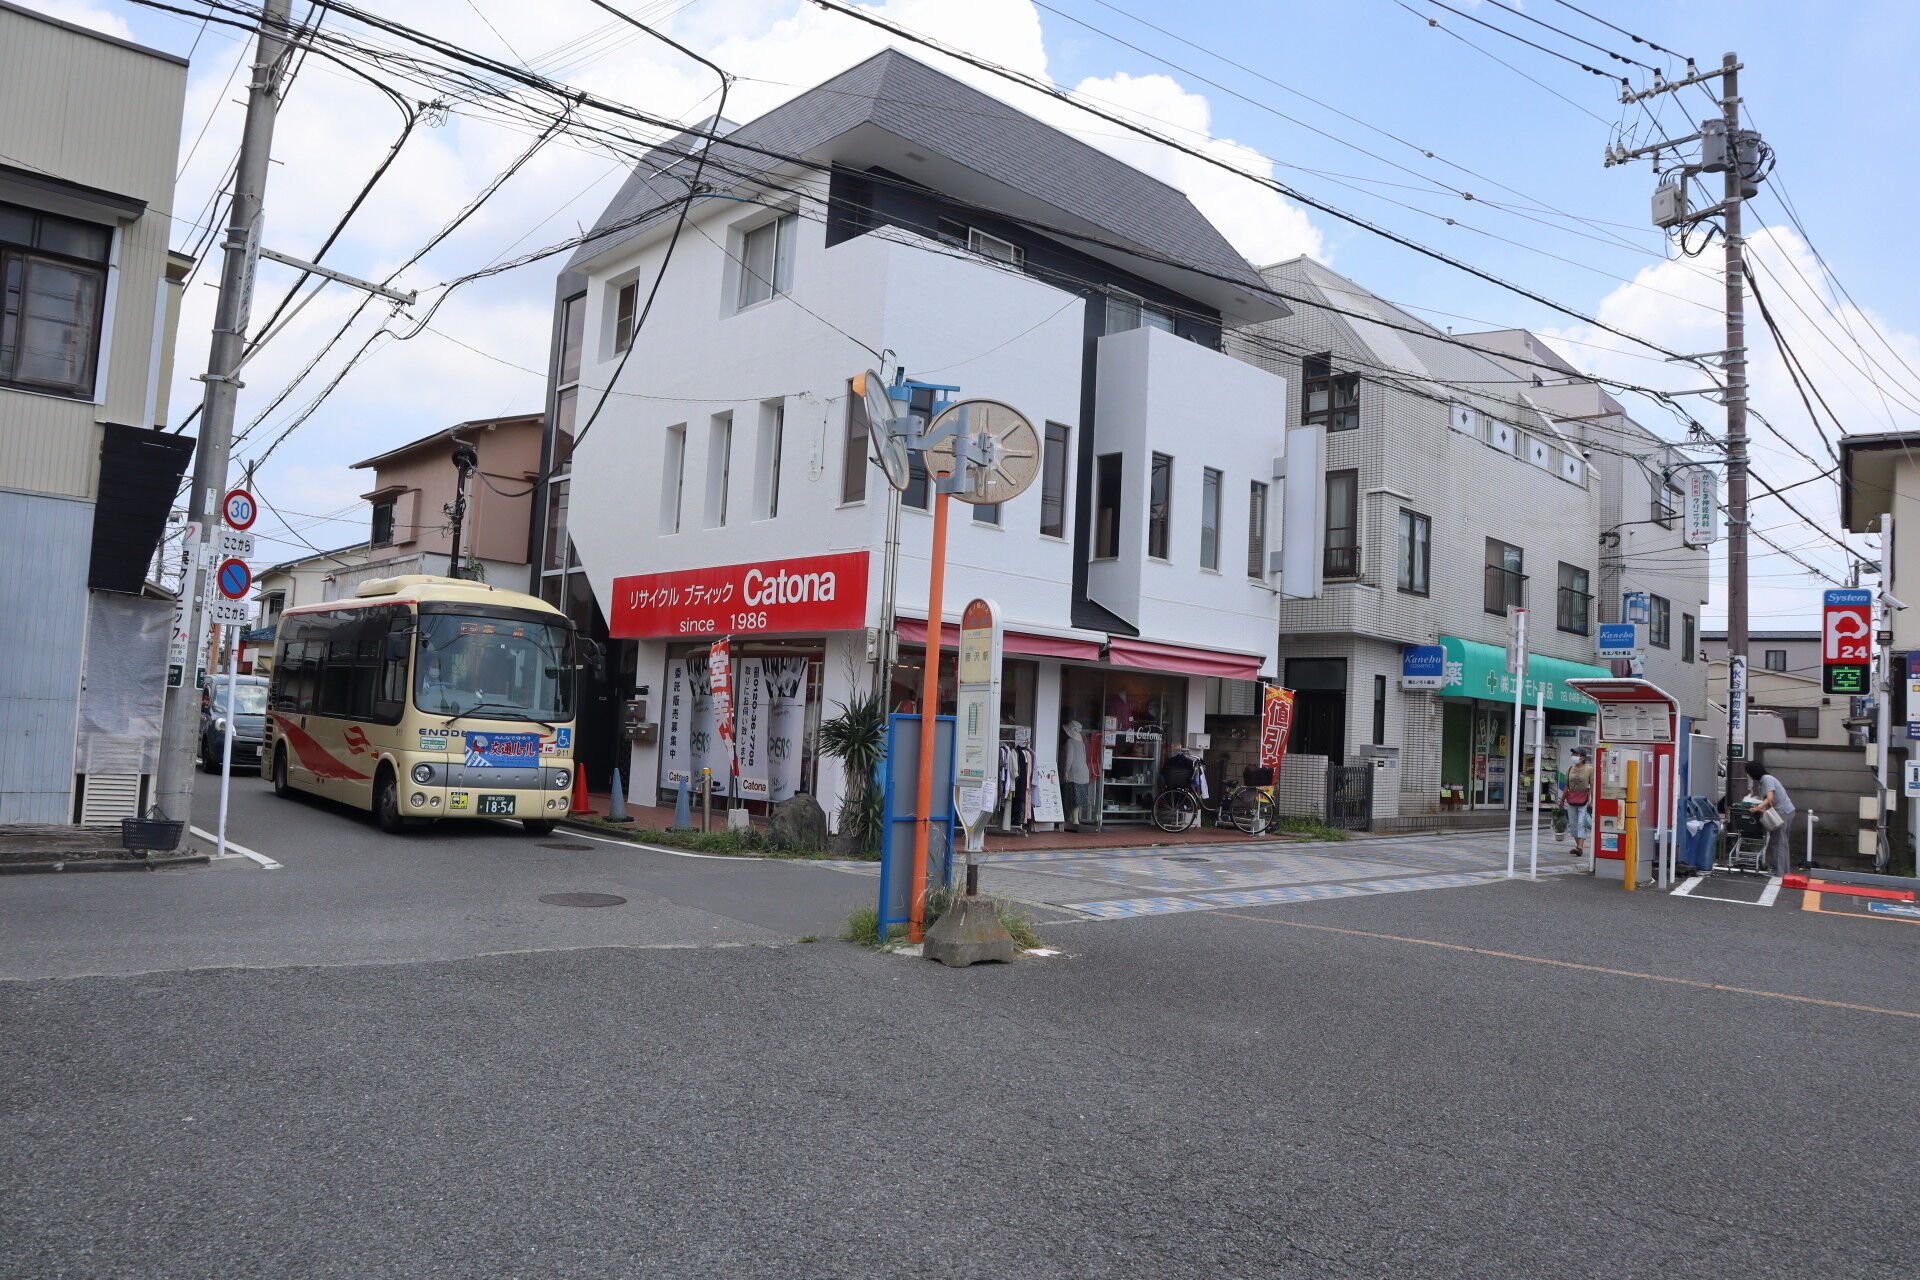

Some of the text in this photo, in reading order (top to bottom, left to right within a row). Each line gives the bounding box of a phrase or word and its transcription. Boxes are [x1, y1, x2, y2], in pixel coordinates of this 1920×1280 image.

[230, 500, 250, 520] 30
[223, 537, 251, 552] ここから
[630, 568, 836, 610] リサイクル ブティック Catona
[1828, 593, 1868, 603] System
[217, 606, 245, 622] ここから
[680, 611, 767, 633] since 1986
[1600, 631, 1634, 639] Kanebo
[1404, 655, 1441, 664] Kanebo
[1841, 645, 1868, 659] 24
[1445, 661, 1463, 687] 薬
[1832, 666, 1861, 691] 空
[670, 667, 682, 760] 委託販売募集中
[748, 678, 760, 767] 0120-36-7708
[490, 740, 536, 757] 交通ルール
[556, 749, 569, 757] 911
[742, 779, 767, 792] Catona
